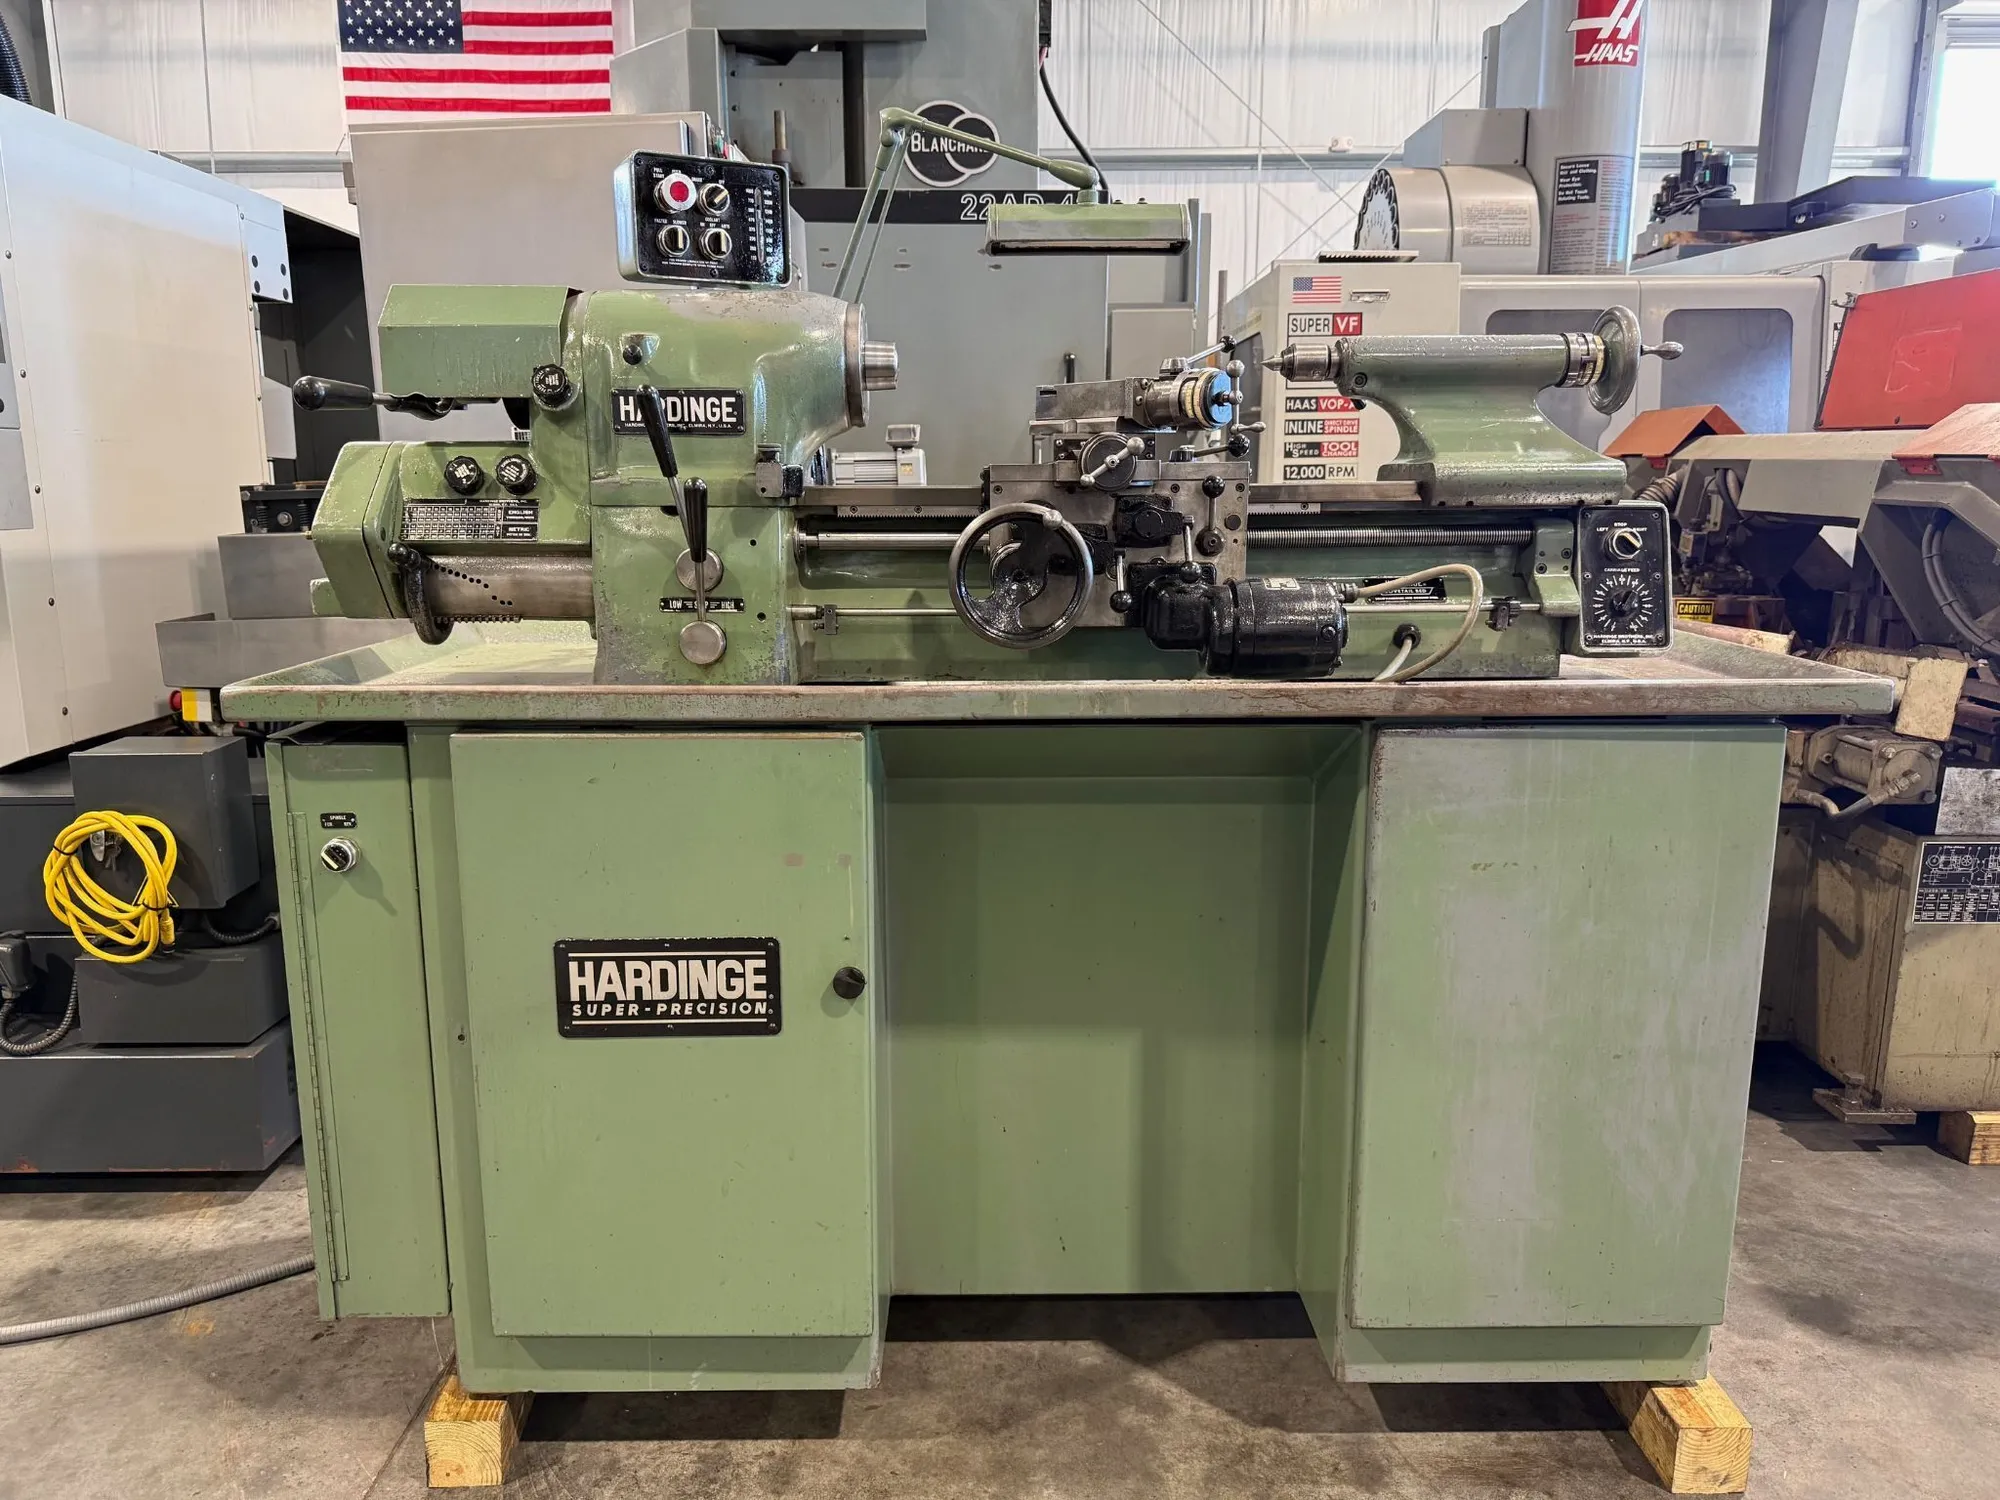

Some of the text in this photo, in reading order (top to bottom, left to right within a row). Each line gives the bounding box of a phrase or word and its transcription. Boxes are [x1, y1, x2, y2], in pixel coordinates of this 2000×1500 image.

[1573, 42, 1640, 63] HAAS
[911, 132, 990, 153] BLANCHA
[1291, 317, 1358, 333] SUPER VF
[619, 396, 737, 422] HDINGE
[1286, 399, 1317, 411] HAAS
[1285, 421, 1323, 434] INLINE
[1286, 443, 1307, 452] HIGH
[1322, 442, 1357, 451] TOOL
[1292, 449, 1319, 458] SPEED
[1285, 466, 1355, 479] 12,000 RPM
[669, 599, 683, 609] LOW
[694, 600, 709, 609] SP
[1679, 604, 1711, 614] CAUTION
[568, 960, 767, 1001] HARDINGE
[572, 1001, 768, 1017] SUPER-PRECISION
